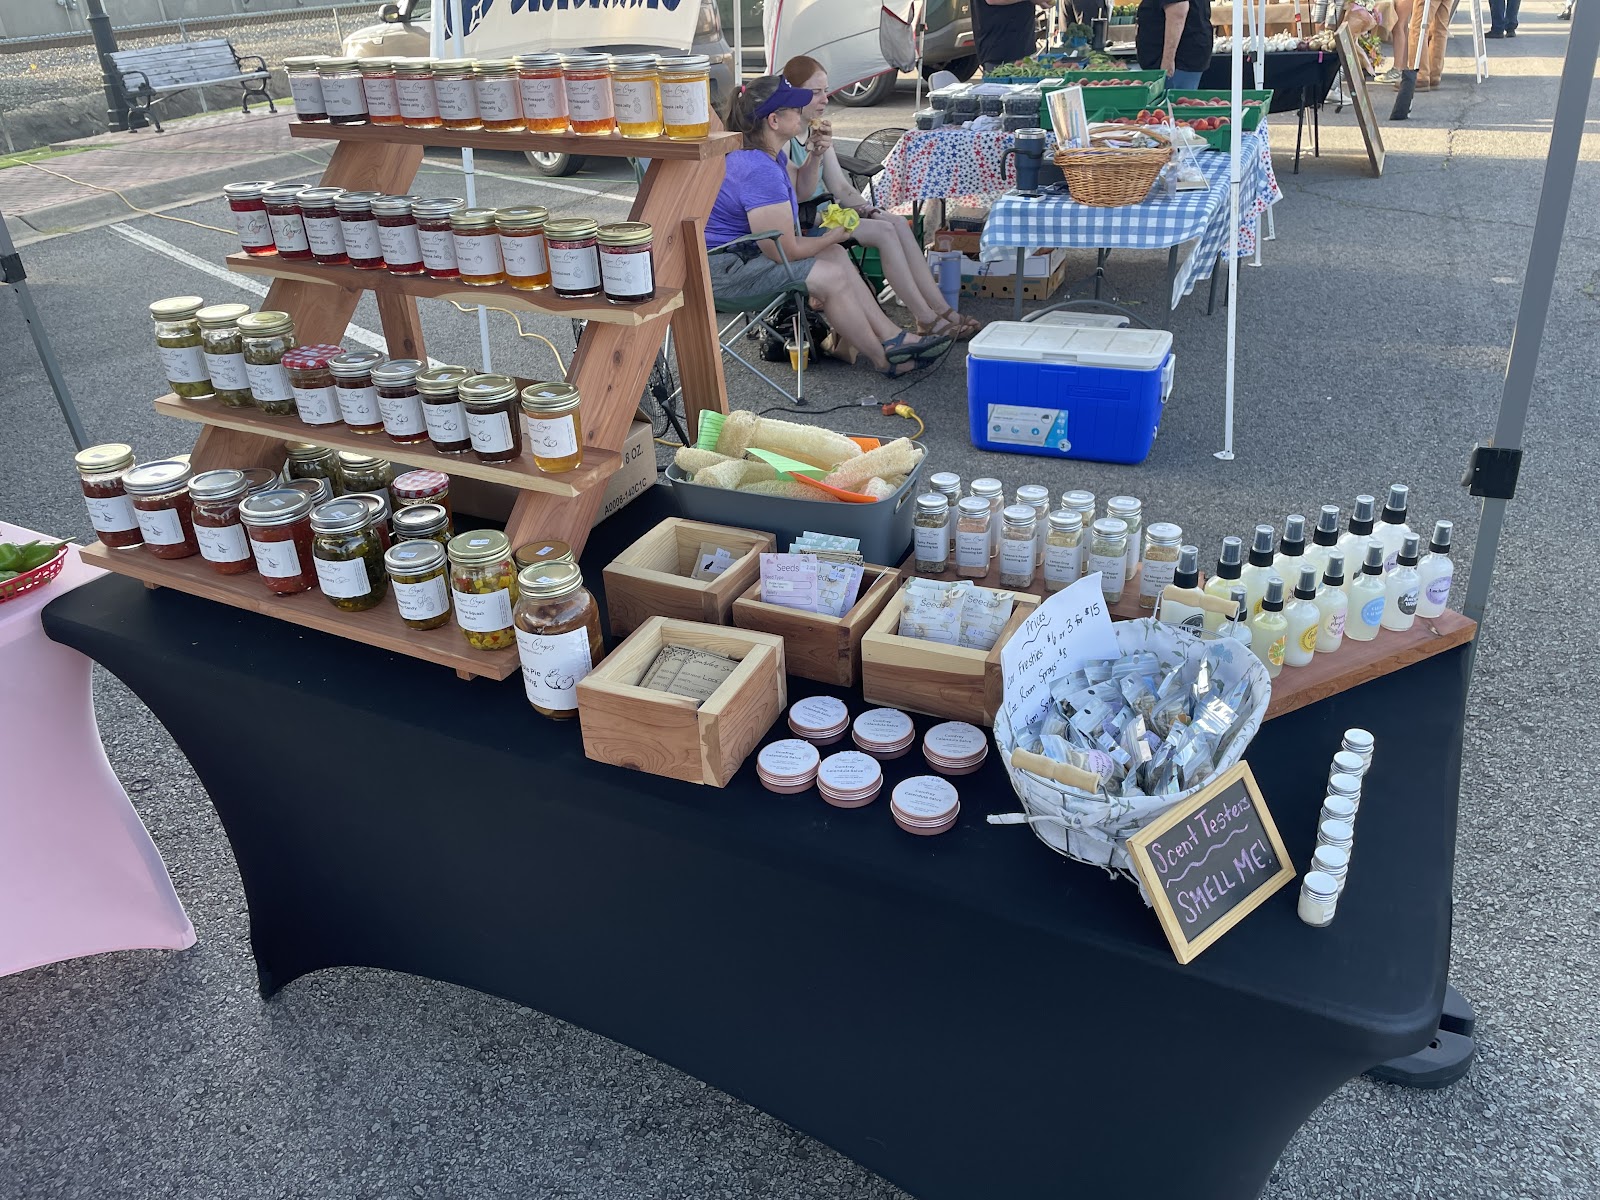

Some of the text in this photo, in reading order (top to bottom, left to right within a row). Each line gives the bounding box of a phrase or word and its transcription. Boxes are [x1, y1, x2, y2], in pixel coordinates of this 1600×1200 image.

[625, 452, 630, 464] 8
[776, 564, 800, 572] Seeds
[920, 599, 945, 608] Seeds
[968, 595, 992, 608] Seeds
[1026, 611, 1046, 635] Prices
[1018, 648, 1043, 675] Freshies
[1059, 630, 1065, 640] or
[1066, 619, 1074, 634] 3
[1075, 614, 1083, 627] for
[1084, 602, 1100, 617] $15
[530, 668, 541, 677] Pie
[1020, 684, 1036, 702] Room
[1038, 662, 1057, 684] Sprays
[1152, 797, 1251, 874] Scent Testers
[1177, 838, 1272, 923] SMELL ME!
